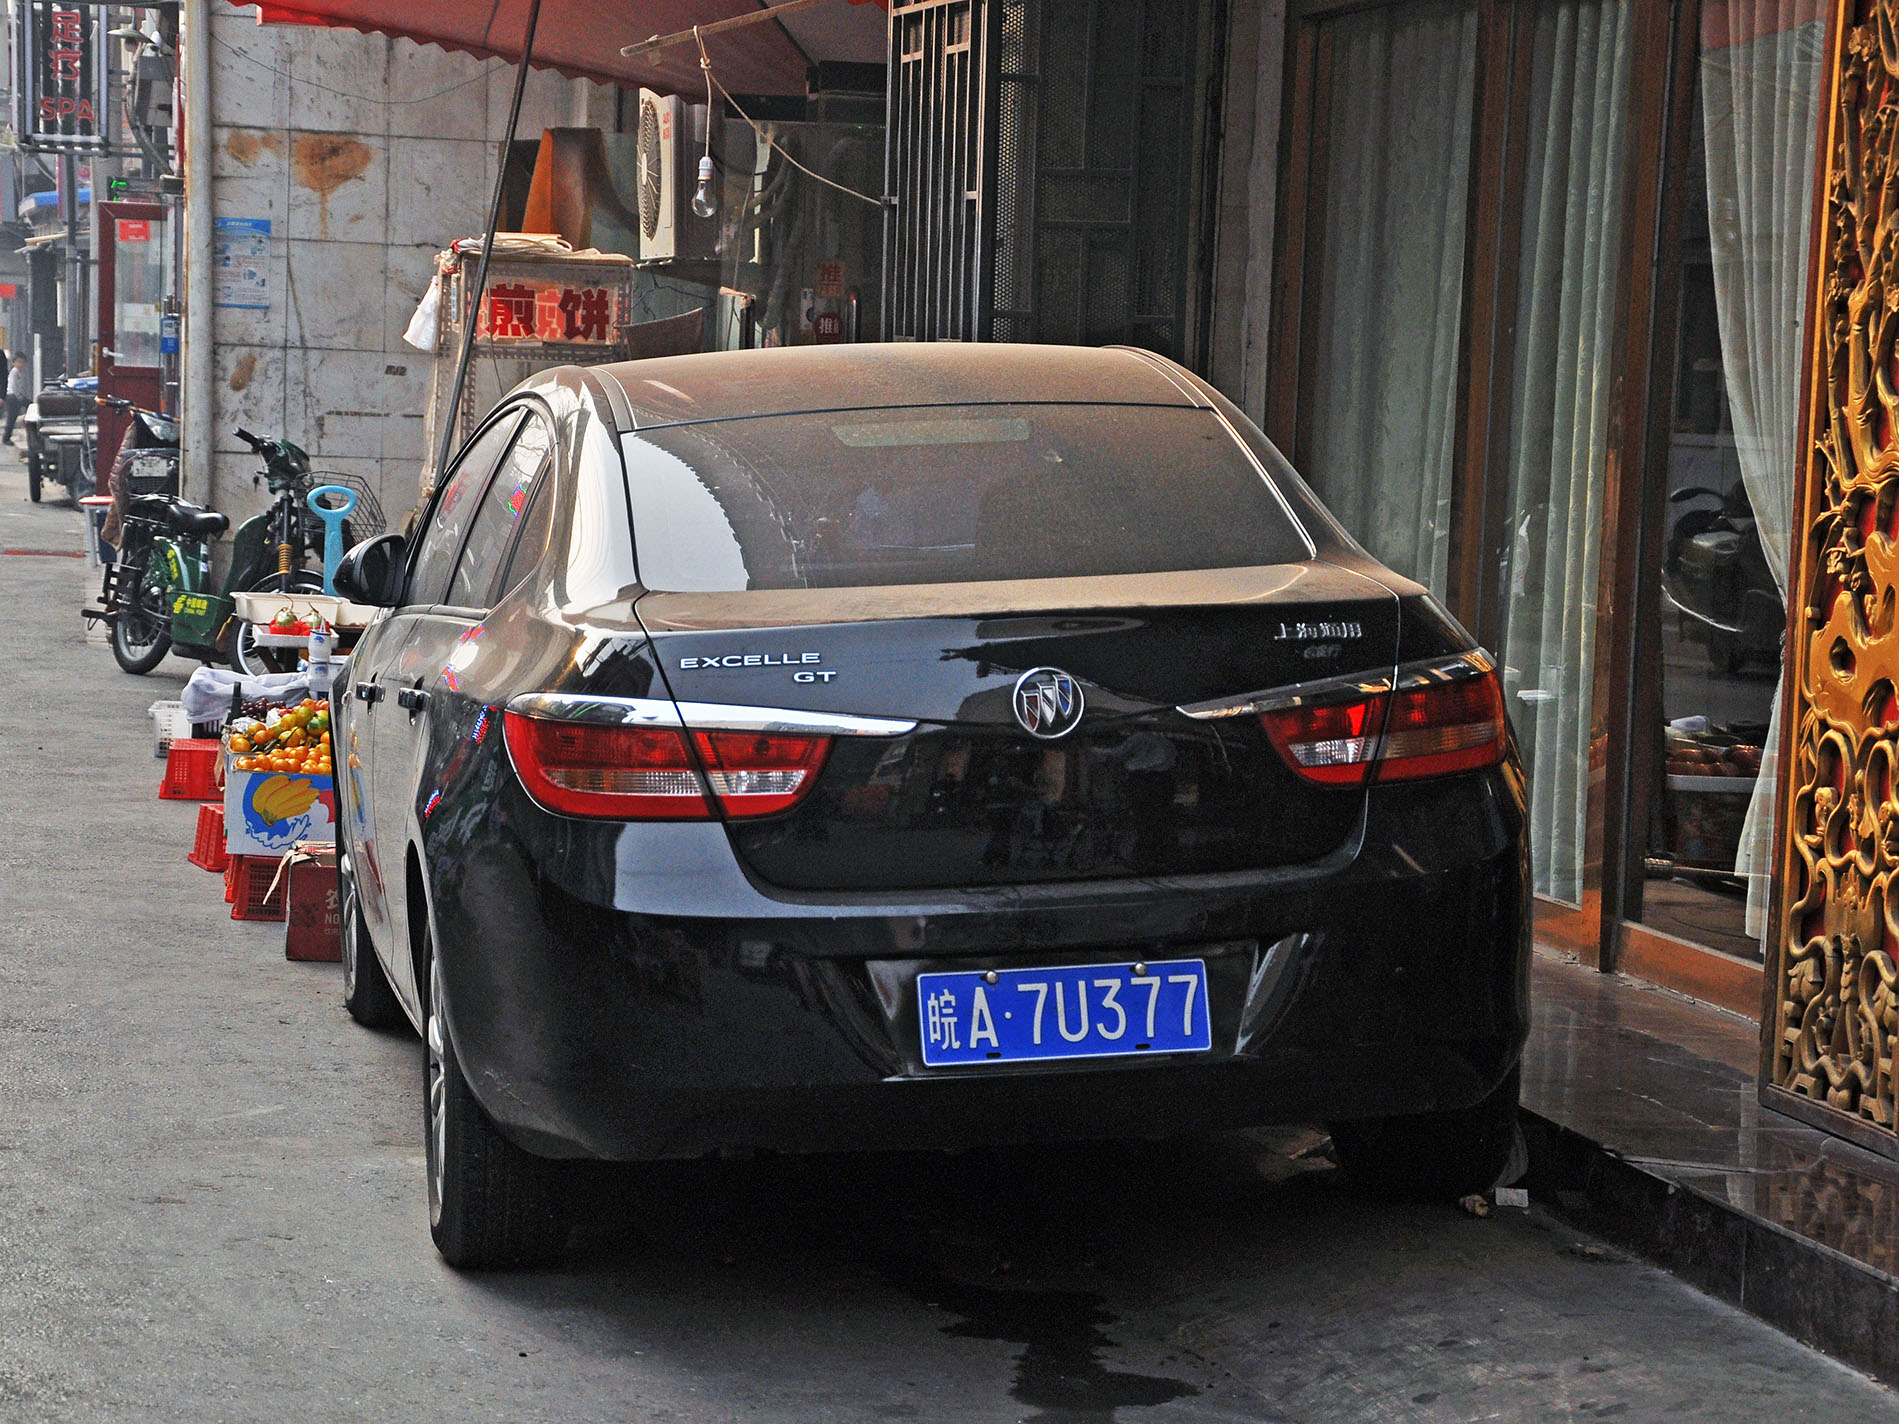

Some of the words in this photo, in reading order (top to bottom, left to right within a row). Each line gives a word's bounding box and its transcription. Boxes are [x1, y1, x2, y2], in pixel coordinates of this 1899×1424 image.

[49, 11, 84, 80] 足疗
[40, 97, 96, 123] SPA
[486, 283, 610, 340] 煎饼
[680, 652, 821, 670] EXCELLE
[793, 671, 837, 683] GT
